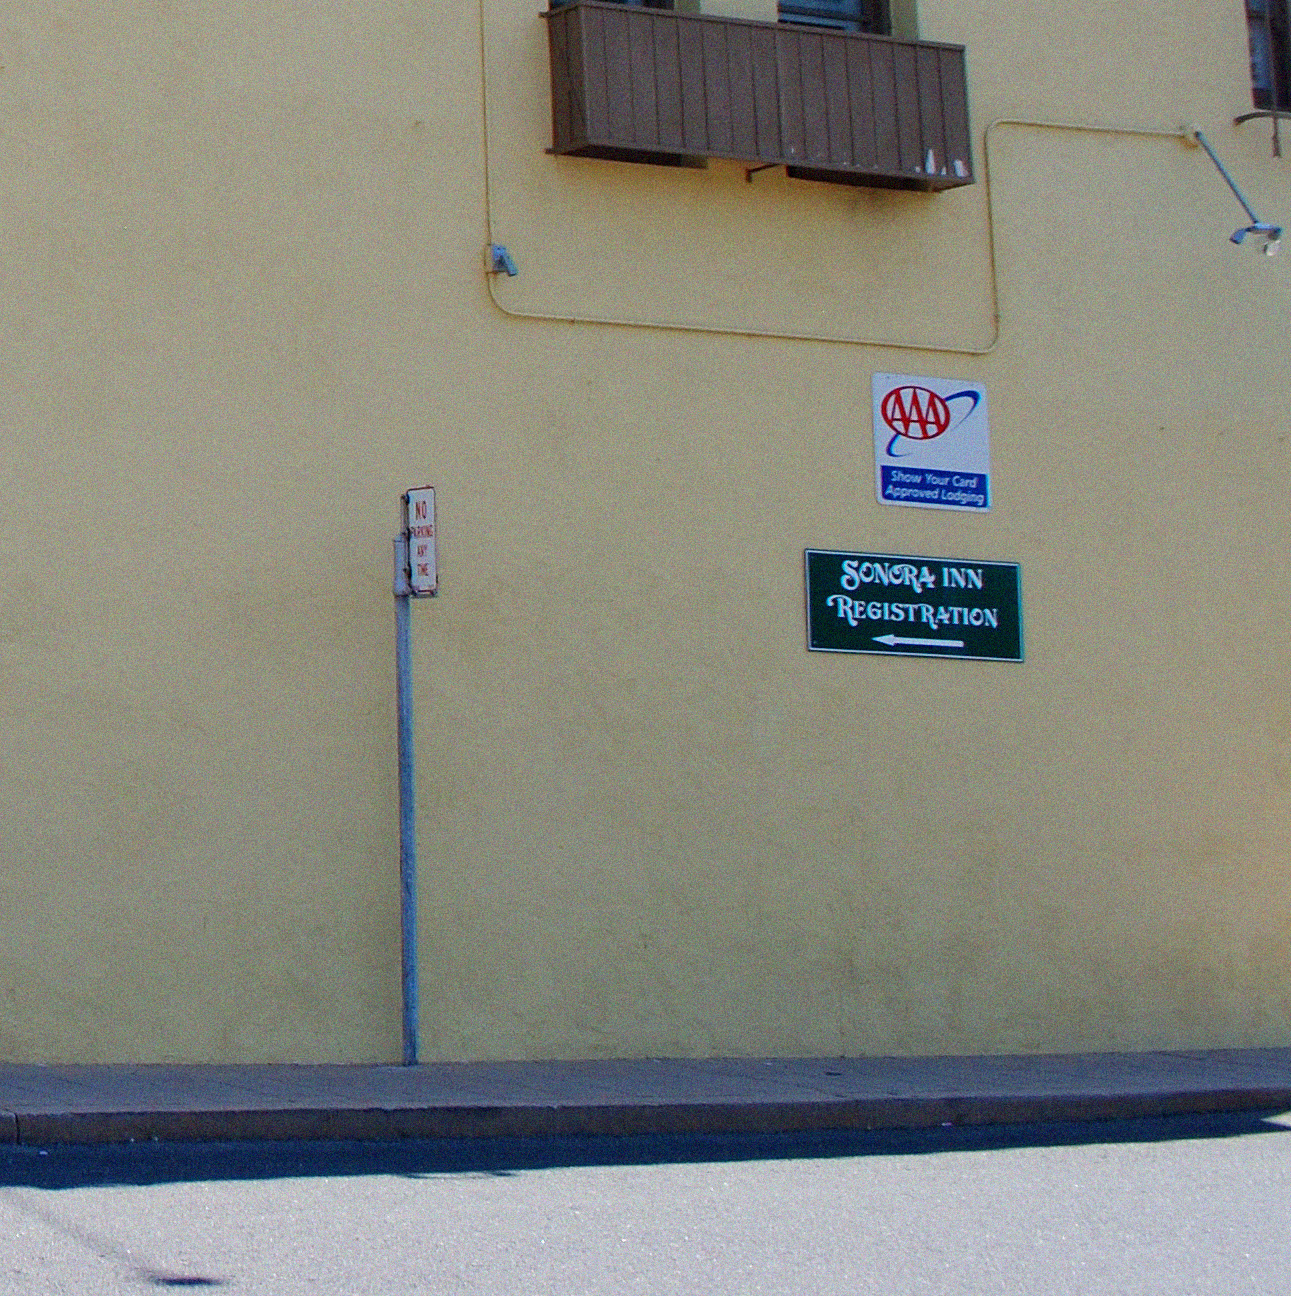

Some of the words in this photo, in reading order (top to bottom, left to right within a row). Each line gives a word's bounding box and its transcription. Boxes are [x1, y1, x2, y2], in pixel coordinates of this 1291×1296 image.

[886, 386, 947, 440] AAA
[890, 469, 923, 484] Show
[924, 473, 950, 486] Your
[952, 475, 979, 489] Card
[885, 484, 940, 499] Approved
[941, 489, 985, 506] Lodging
[415, 500, 428, 520] NO
[840, 559, 936, 594] SONORA
[941, 566, 984, 590] INN
[826, 593, 999, 630] REGISTRATION
